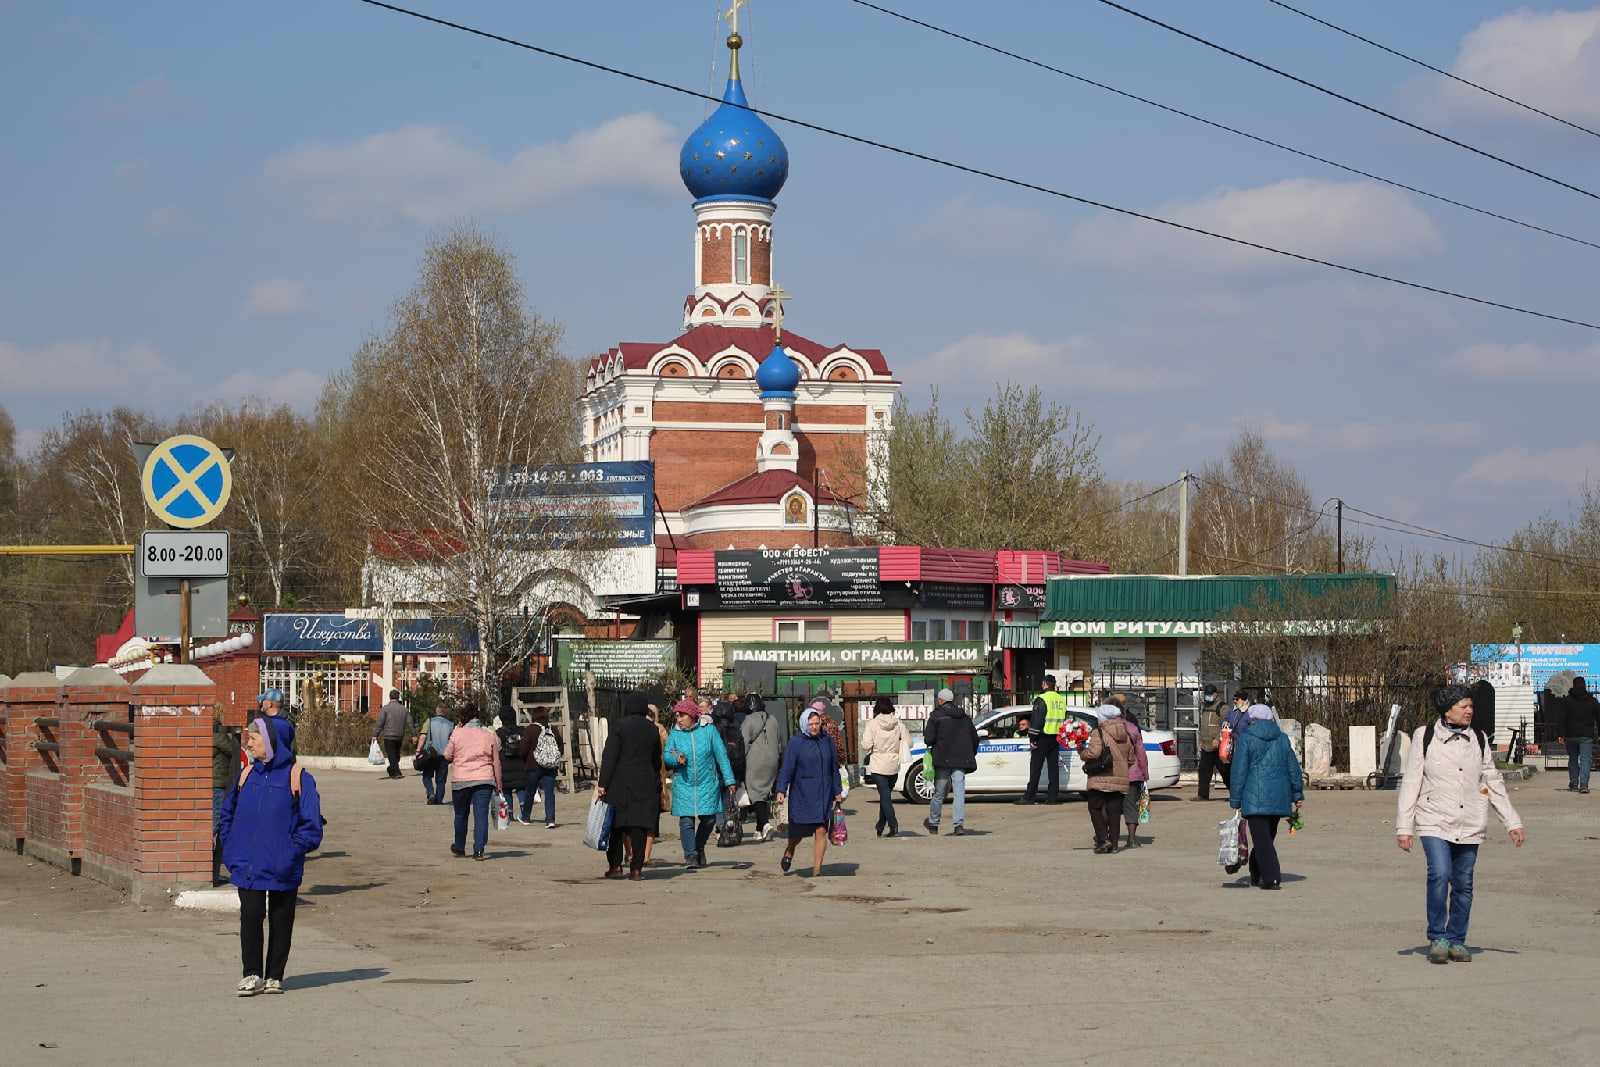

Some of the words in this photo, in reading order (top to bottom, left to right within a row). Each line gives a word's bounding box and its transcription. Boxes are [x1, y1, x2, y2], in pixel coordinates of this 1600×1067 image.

[762, 549, 781, 559] ООО
[782, 548, 830, 558] «ГЕФЕСТ»
[293, 617, 371, 646] Искусство
[1053, 621, 1106, 636] ДОМ
[732, 649, 836, 664] ПАМЯТНИКИ,
[840, 649, 919, 662] ОГРАДКИ,
[923, 648, 978, 661] ВЕНКИ
[865, 705, 929, 720] ЦТЫ
